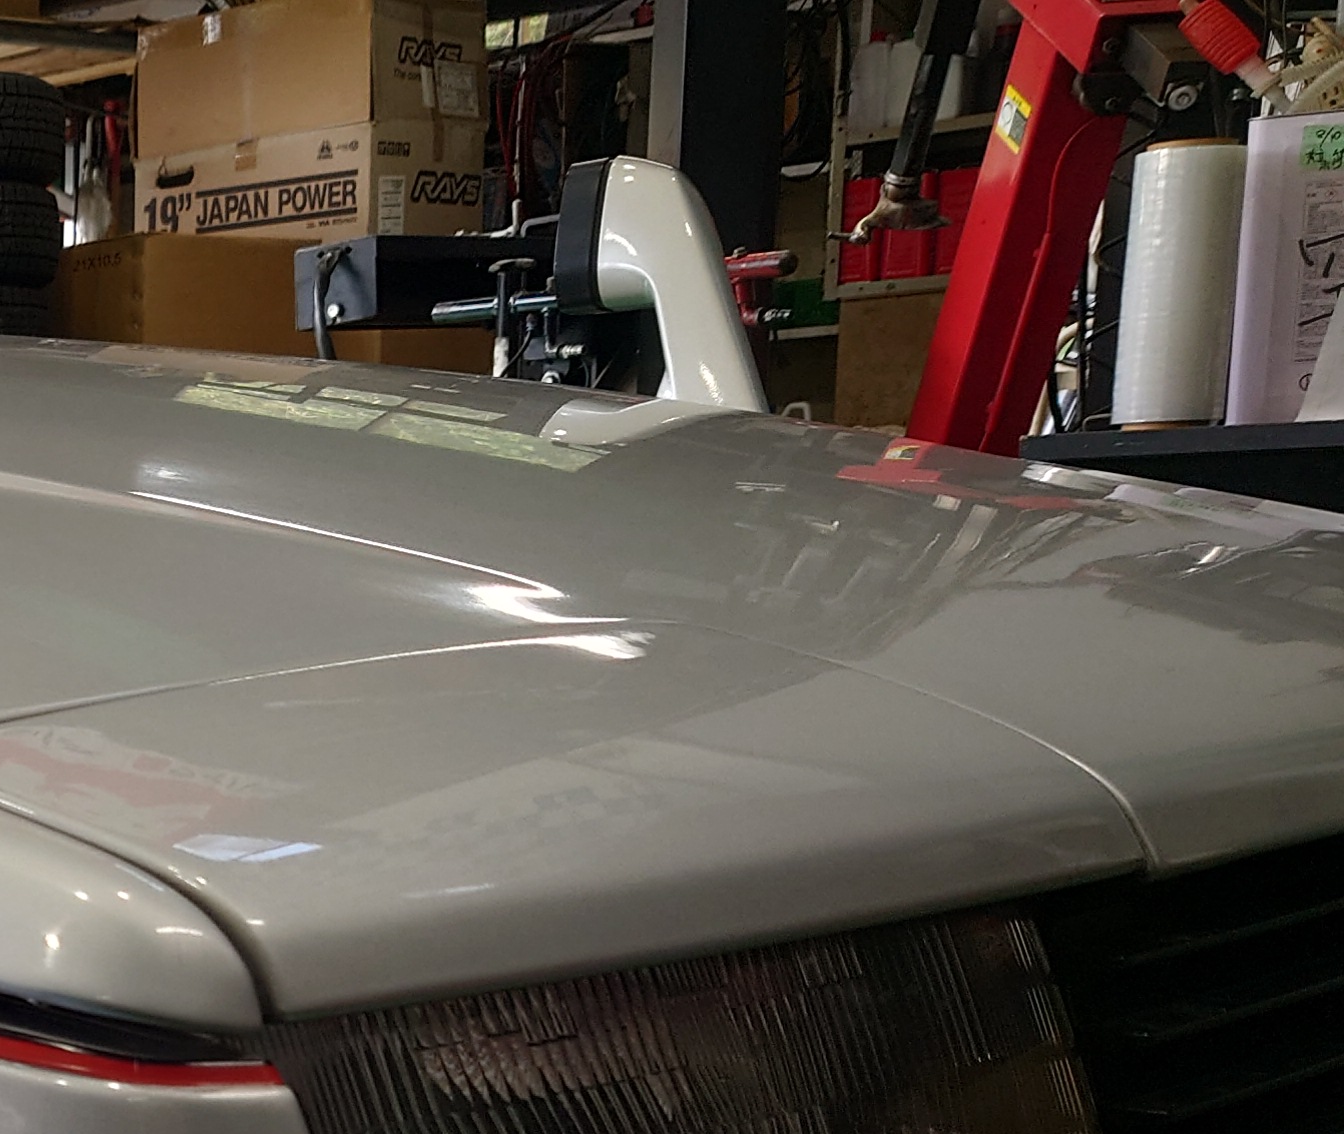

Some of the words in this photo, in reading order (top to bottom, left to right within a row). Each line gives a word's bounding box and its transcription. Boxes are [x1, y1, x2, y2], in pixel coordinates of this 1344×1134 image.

[196, 190, 269, 227] JAPAN
[278, 179, 358, 215] POWER
[411, 170, 482, 207] RAYS
